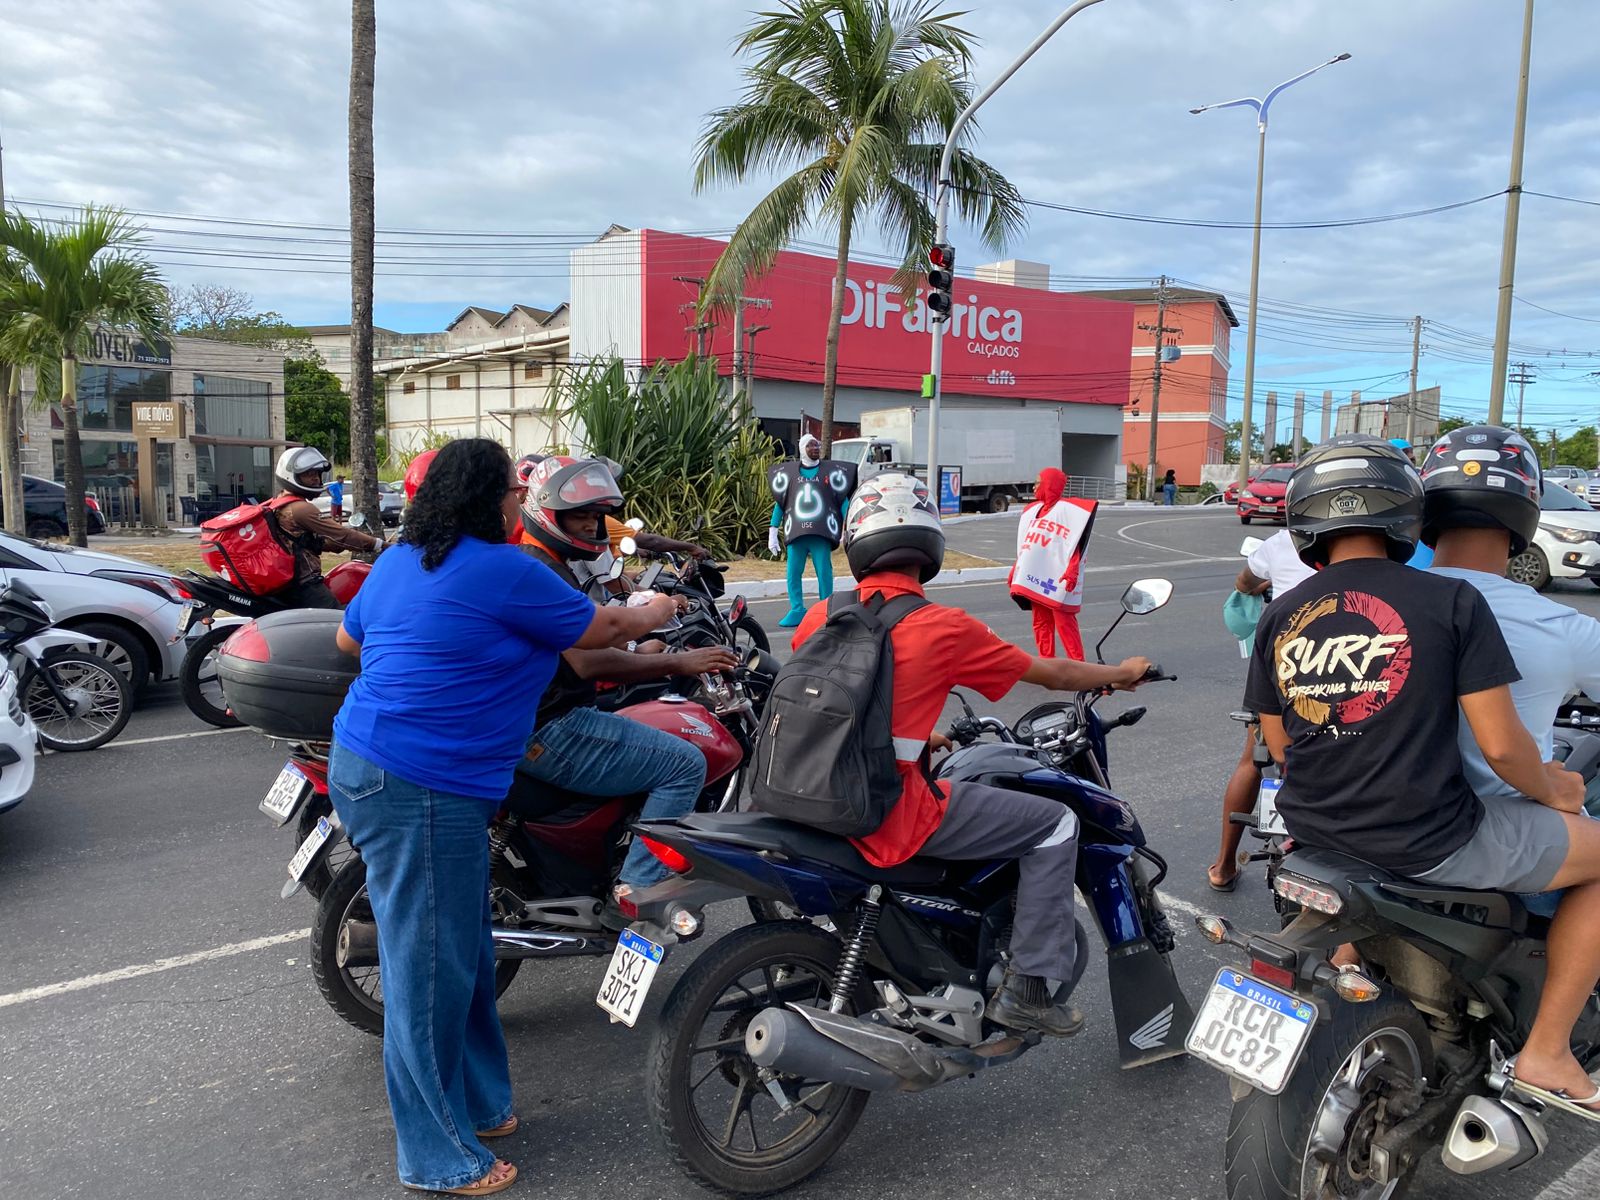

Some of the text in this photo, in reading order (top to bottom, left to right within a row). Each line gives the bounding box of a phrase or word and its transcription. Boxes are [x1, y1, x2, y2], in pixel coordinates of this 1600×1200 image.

[967, 342, 1019, 358] CALÇADOS
[152, 403, 174, 421] MÓVEIS
[801, 521, 813, 529] USE
[1030, 519, 1070, 540] TESTE
[1024, 532, 1052, 548] HIV
[1026, 574, 1040, 585] SUS
[228, 594, 251, 606] YAMAHA
[1279, 634, 1408, 681] SURF
[1288, 680, 1391, 698] BREAKING WAVES
[681, 727, 715, 739] HONDA
[631, 941, 648, 955] BRASIL
[617, 950, 647, 985] SKJ
[1246, 988, 1281, 1011] BRASIL
[1224, 995, 1286, 1044] RCR
